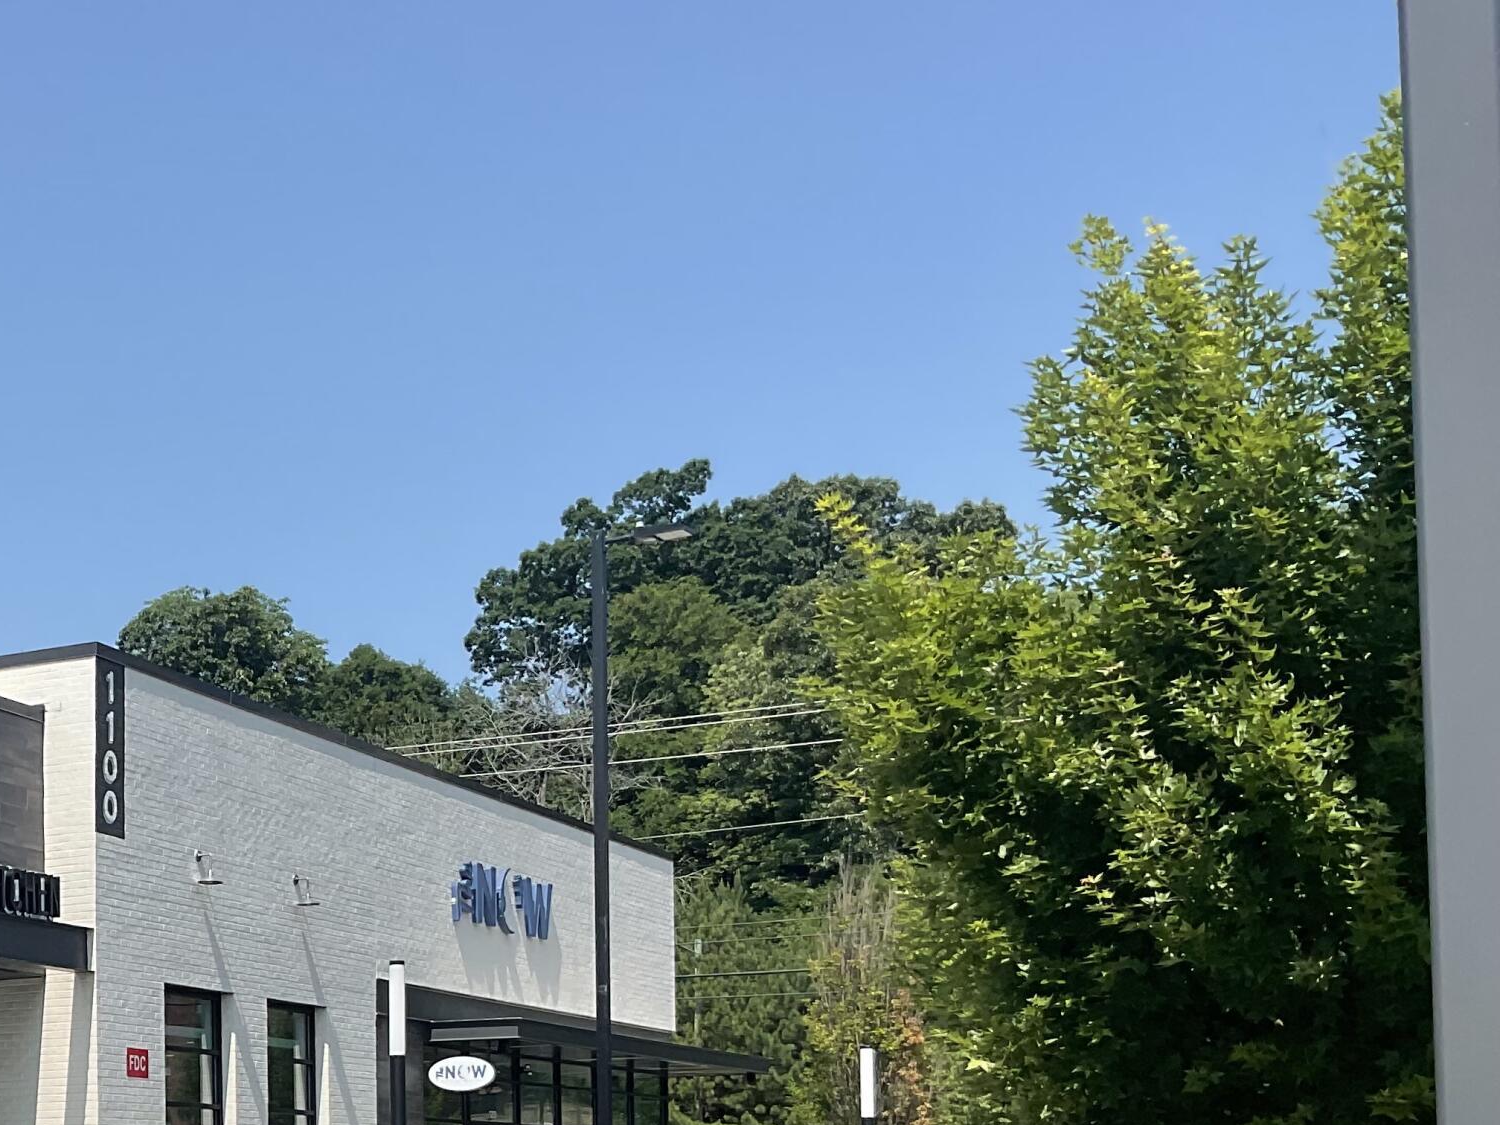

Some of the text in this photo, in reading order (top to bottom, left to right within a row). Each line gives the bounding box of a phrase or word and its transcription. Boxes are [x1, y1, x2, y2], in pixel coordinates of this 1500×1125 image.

[102, 670, 119, 825] 1100
[129, 1054, 146, 1072] FDC
[445, 1064, 487, 1080] NOW
